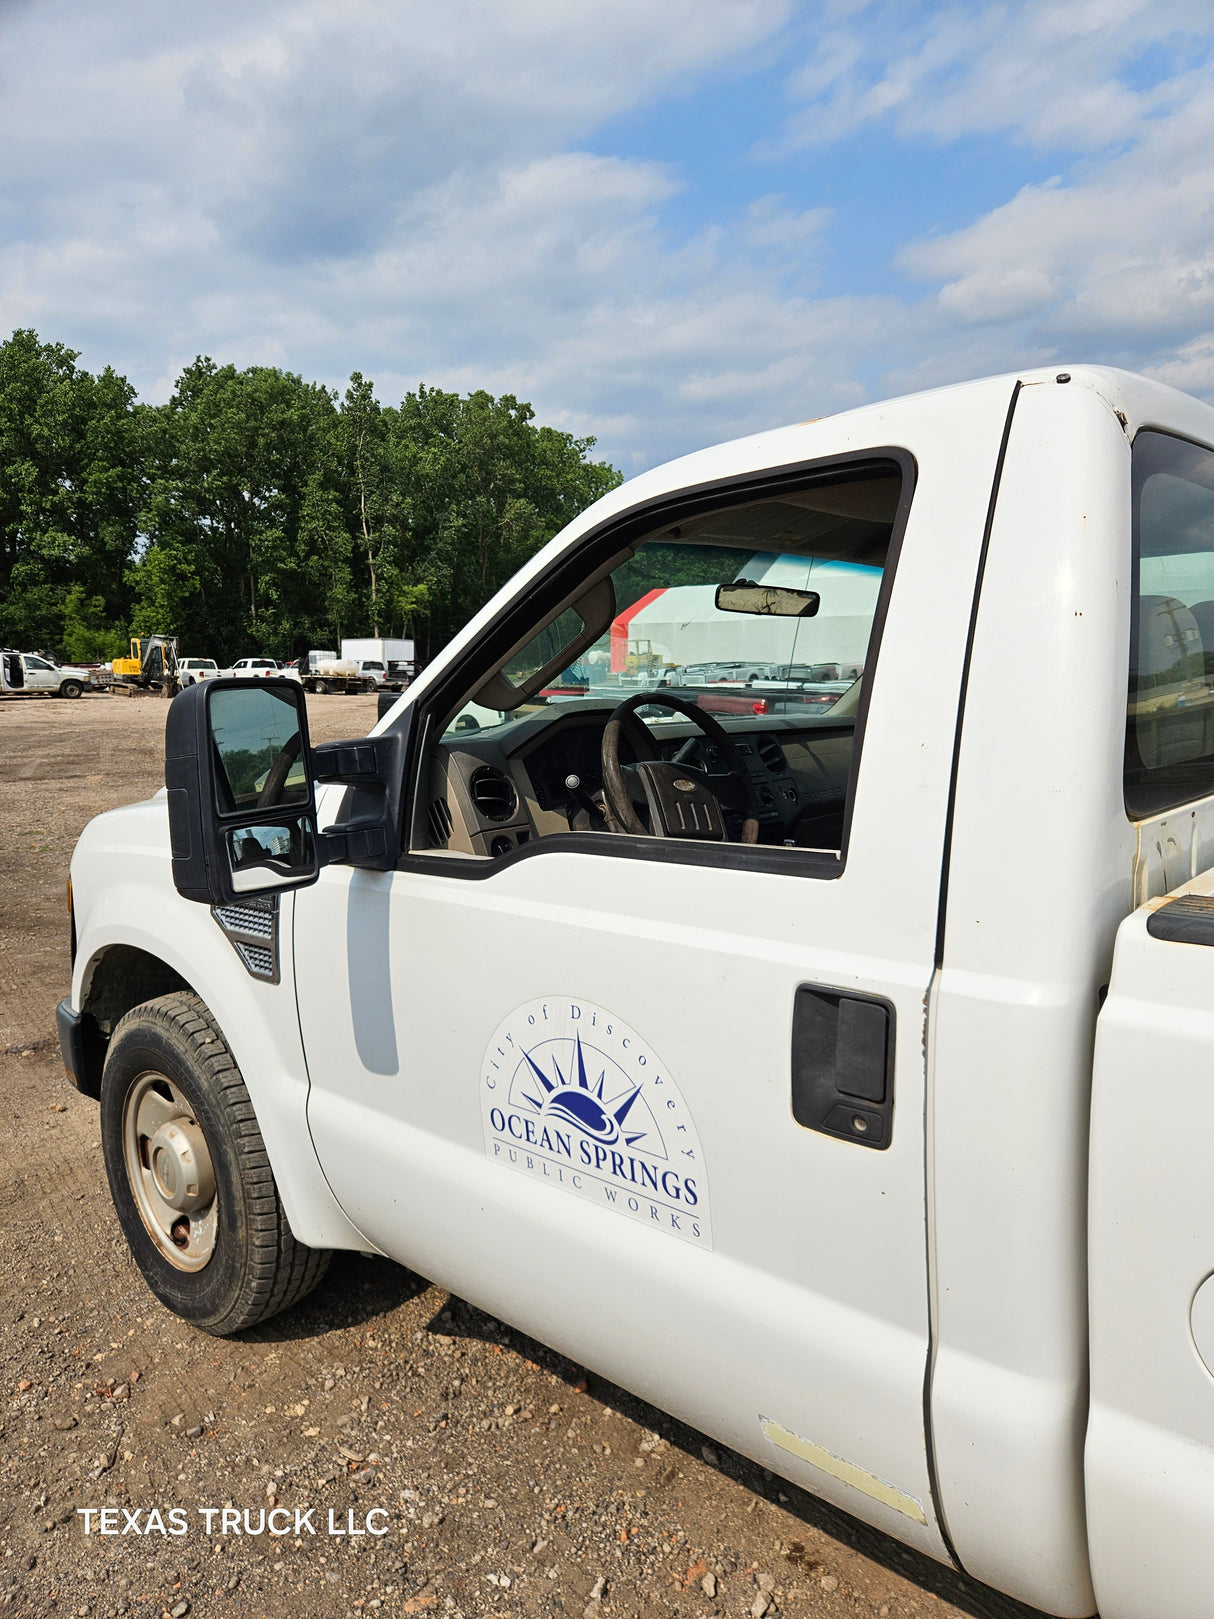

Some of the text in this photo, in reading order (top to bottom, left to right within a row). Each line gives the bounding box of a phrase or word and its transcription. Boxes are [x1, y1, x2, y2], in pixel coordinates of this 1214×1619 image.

[486, 1003, 695, 1160] City of Discovery
[489, 1107, 699, 1206] OCEAN SPRINGS
[494, 1143, 701, 1238] PUBLIC WORKS
